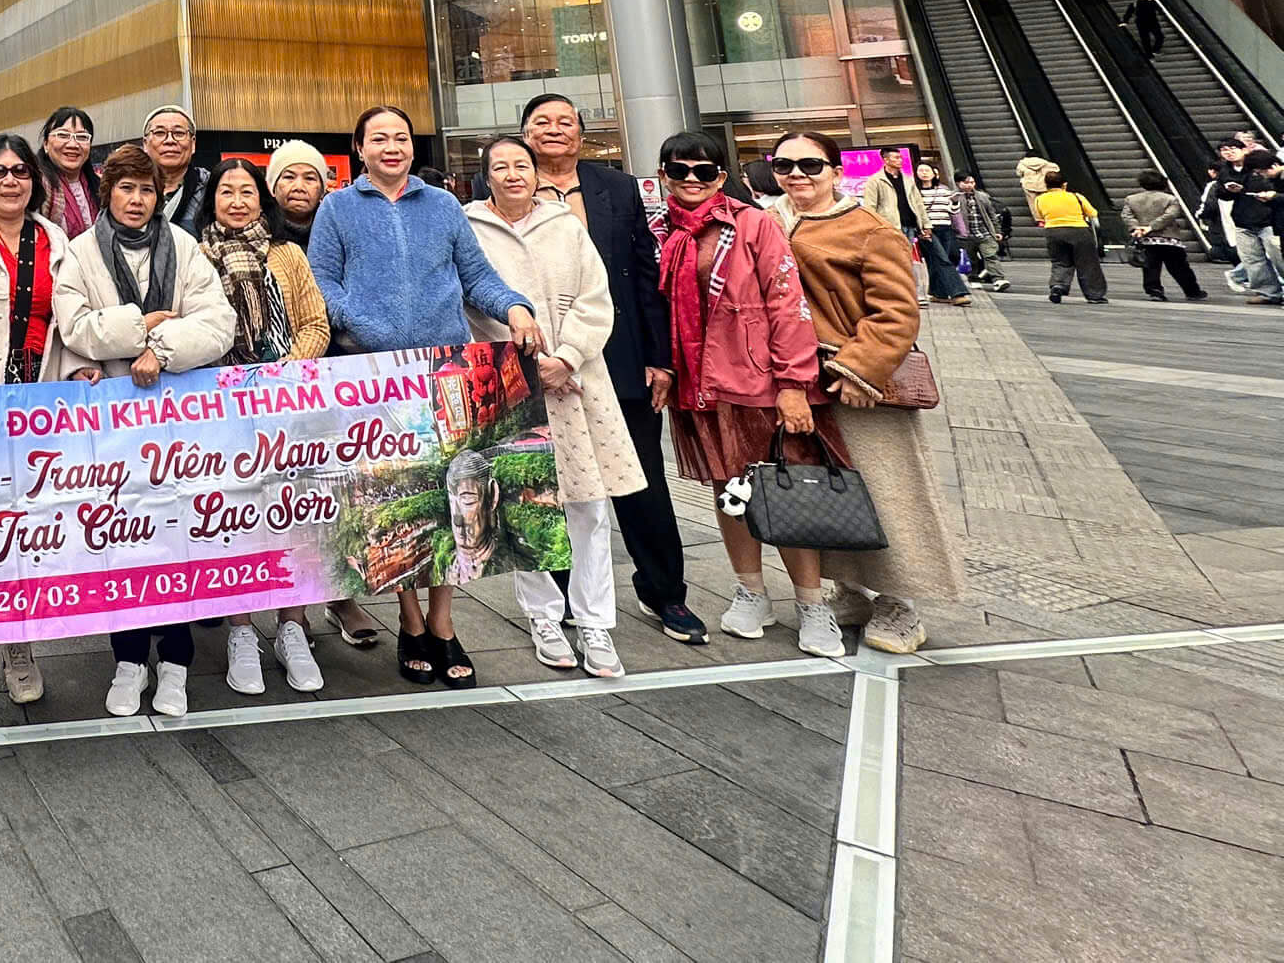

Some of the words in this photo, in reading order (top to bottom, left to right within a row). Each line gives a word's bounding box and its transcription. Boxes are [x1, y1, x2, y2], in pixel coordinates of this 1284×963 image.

[561, 32, 597, 45] TORY
[6, 398, 100, 437] ĐOÀN
[111, 388, 225, 429] KHÁCH
[232, 383, 327, 417] THAM
[334, 374, 429, 407] QUAN
[26, 450, 131, 507] Trang
[141, 441, 226, 487] Viên
[233, 431, 330, 479] Mạn
[335, 418, 420, 463] Hoa
[77, 501, 156, 551] Câu
[189, 492, 260, 544] Lạc
[266, 485, 337, 530] Sơn
